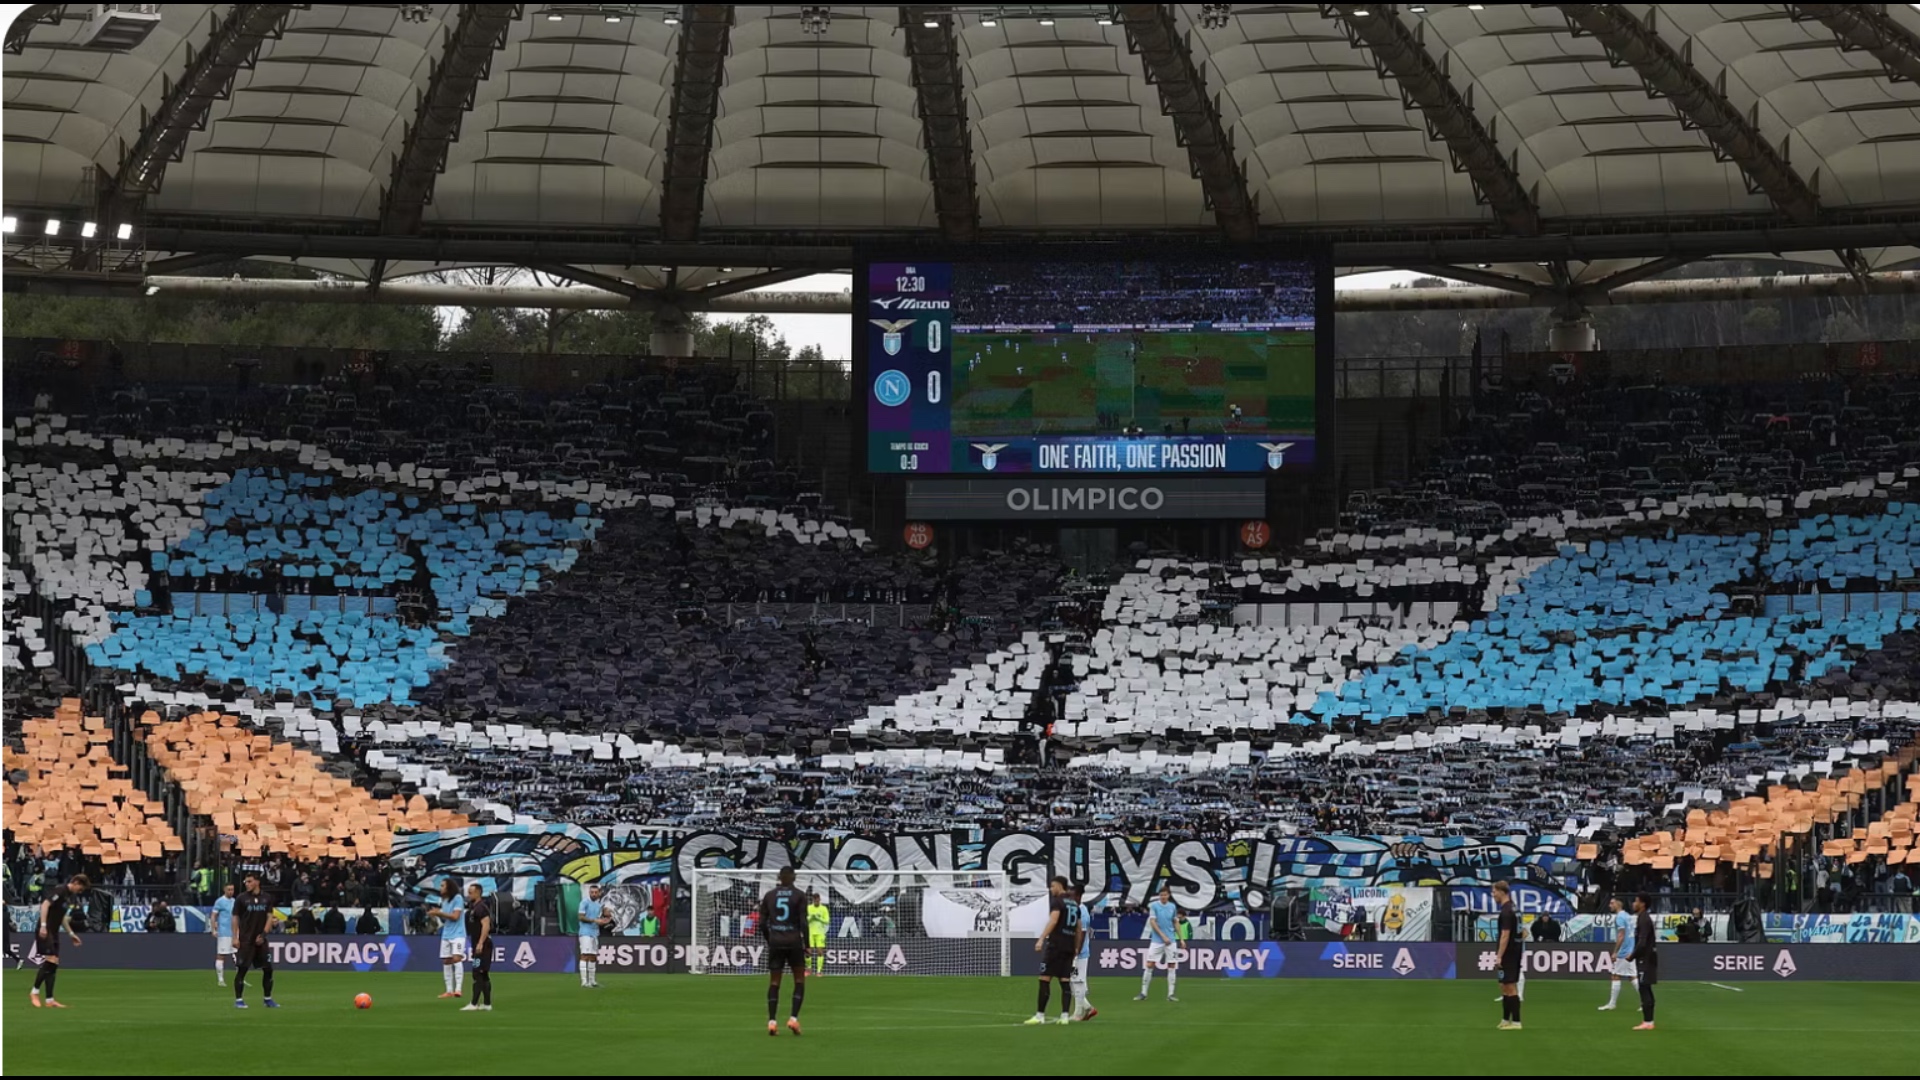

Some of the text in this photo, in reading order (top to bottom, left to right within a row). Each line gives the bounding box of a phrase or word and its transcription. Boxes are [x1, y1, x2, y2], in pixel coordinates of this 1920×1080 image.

[895, 276, 925, 292] 12:30
[896, 298, 950, 309] MIZUNO
[928, 320, 941, 352] 0
[928, 370, 941, 404] 0
[900, 454, 918, 470] 0:0
[1039, 444, 1226, 471] ONE FAITH, ONE PASSION
[1006, 487, 1164, 511] OLIMPICO
[908, 533, 928, 545] AD
[1245, 533, 1263, 545] AS
[987, 834, 1214, 910] GUYS
[775, 897, 790, 922] 5
[1065, 905, 1078, 928] 13
[268, 942, 396, 964] TOPIRACY
[825, 949, 876, 964] SERIE
[1099, 948, 1271, 971] #STPIRACY
[1332, 953, 1384, 969] SERIE
[1713, 955, 1765, 971] SERIE
